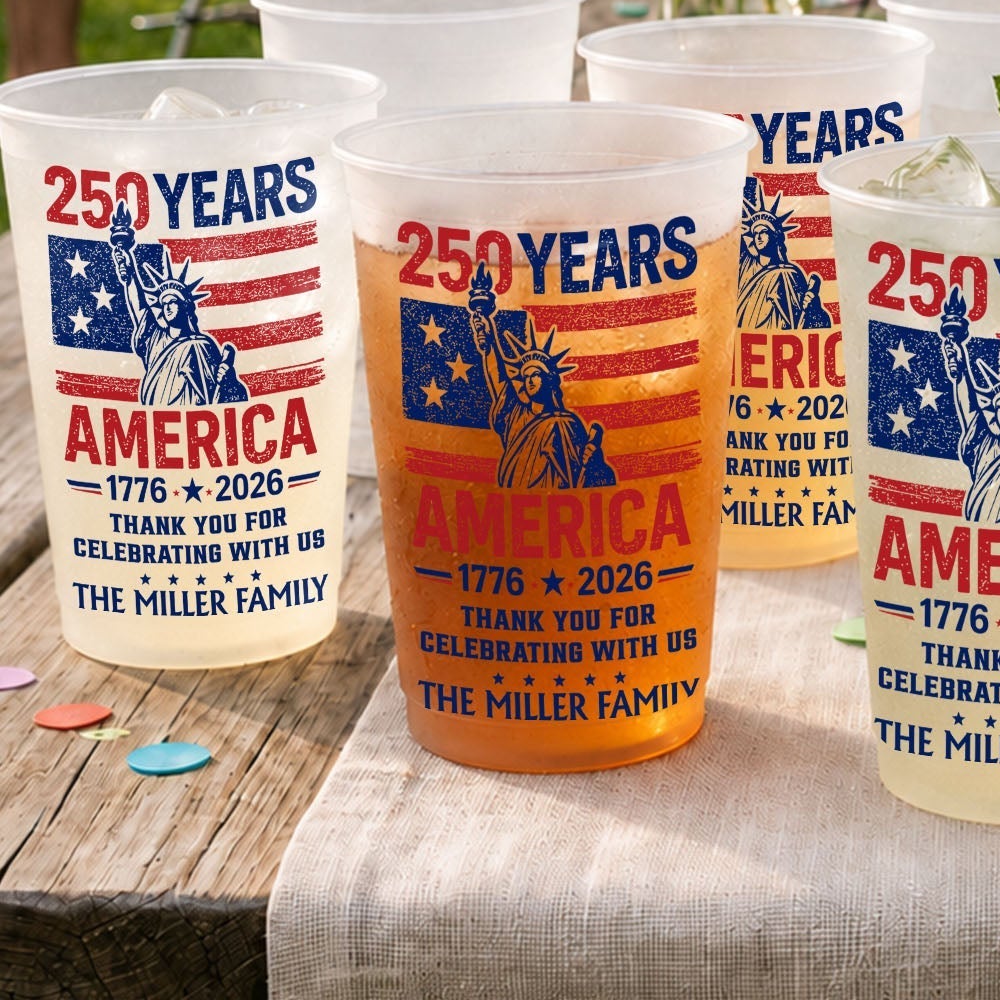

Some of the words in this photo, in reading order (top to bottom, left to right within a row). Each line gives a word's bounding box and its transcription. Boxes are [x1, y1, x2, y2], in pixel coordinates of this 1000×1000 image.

[45, 166, 149, 230] 250
[153, 157, 316, 229] YEARS
[398, 222, 512, 295] 250
[518, 216, 697, 294] YEARS
[869, 241, 987, 321] 250
[731, 332, 845, 389] ERIC
[797, 394, 848, 420] 202
[65, 398, 316, 469] AMERICA
[727, 431, 767, 450] ANK
[776, 433, 815, 450] YOU
[824, 431, 848, 449] FO
[727, 458, 799, 477] RATING
[807, 456, 852, 477] WIT
[107, 475, 166, 503] 1776
[216, 469, 283, 501] 2026
[110, 514, 185, 535] THANK
[194, 514, 236, 535] YOU
[245, 508, 286, 531] FOR
[413, 482, 691, 559] AMERICA
[722, 501, 803, 526] MILLER
[74, 538, 221, 564] CELEBRATING
[229, 536, 289, 561] WITH
[298, 529, 324, 551] US
[73, 583, 125, 613] THE
[134, 590, 228, 616] MILLER
[236, 574, 328, 613] FAMILY
[458, 563, 524, 596] 1776
[579, 561, 652, 595] 2026
[461, 606, 543, 631] THANK
[554, 610, 600, 631] YOU
[611, 604, 655, 628] FOR
[921, 598, 988, 633] 1776
[421, 631, 582, 663] CELEBRATING
[591, 635, 657, 661] WITH
[668, 629, 696, 652] US
[419, 680, 475, 715] THE
[486, 690, 587, 720] MILLER
[875, 718, 933, 756] THE
